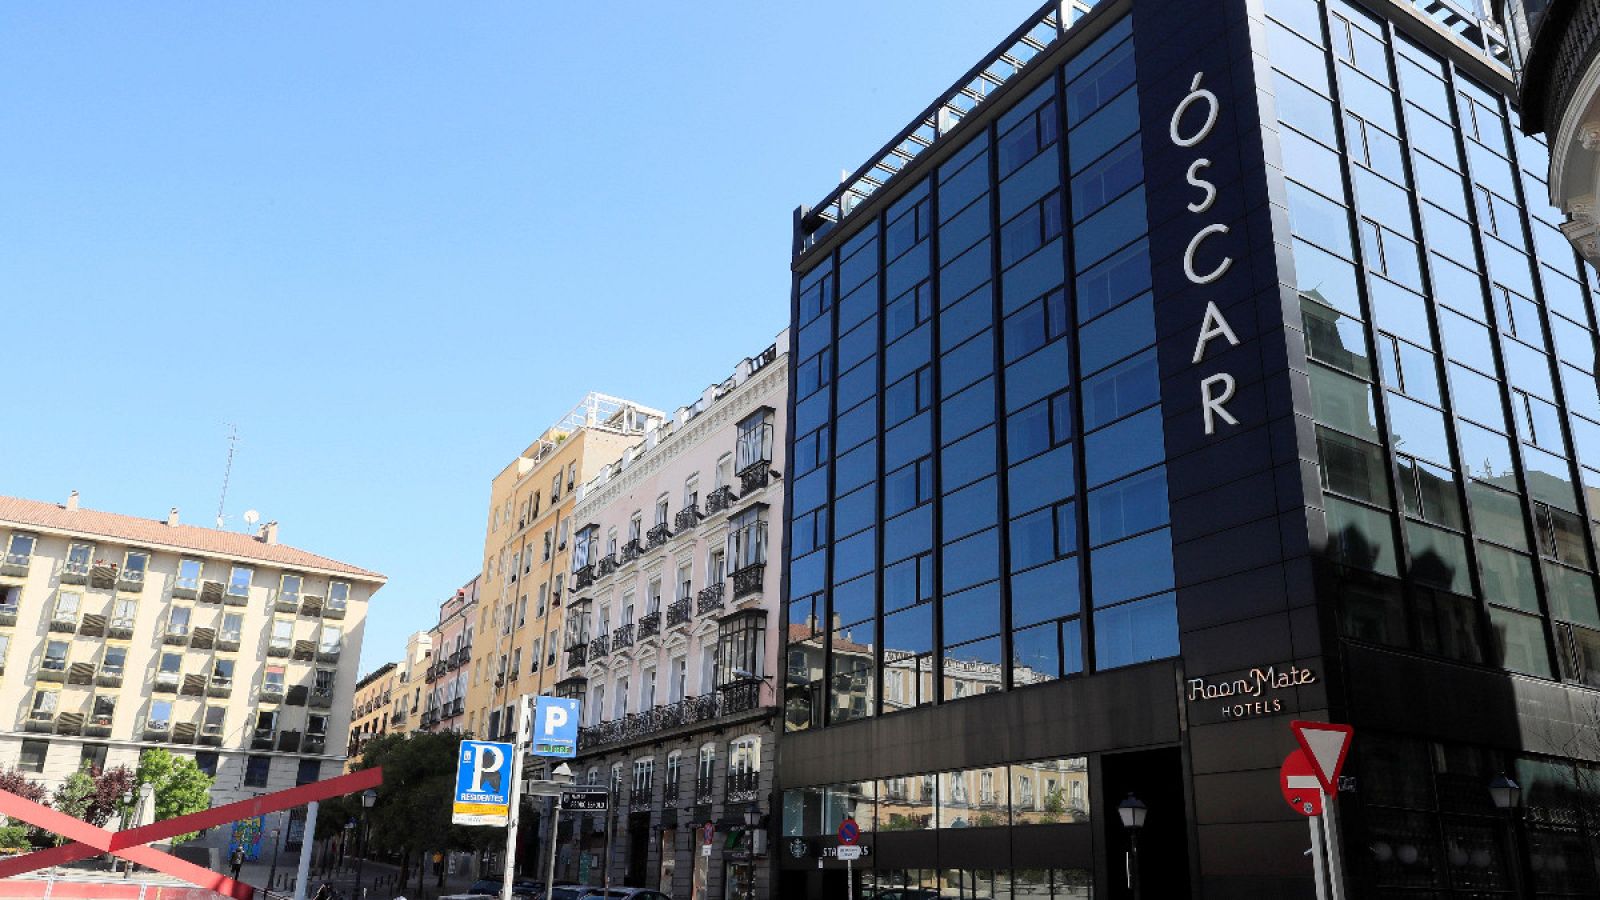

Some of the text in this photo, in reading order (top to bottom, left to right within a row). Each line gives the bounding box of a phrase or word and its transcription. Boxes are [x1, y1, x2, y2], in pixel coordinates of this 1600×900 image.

[1170, 71, 1241, 435] ÓSCAR
[1188, 666, 1316, 701] Room Mate
[544, 706, 568, 735] P
[1222, 699, 1281, 717] HOTELS
[466, 743, 504, 793] P
[460, 792, 504, 803] RESIDENTES
